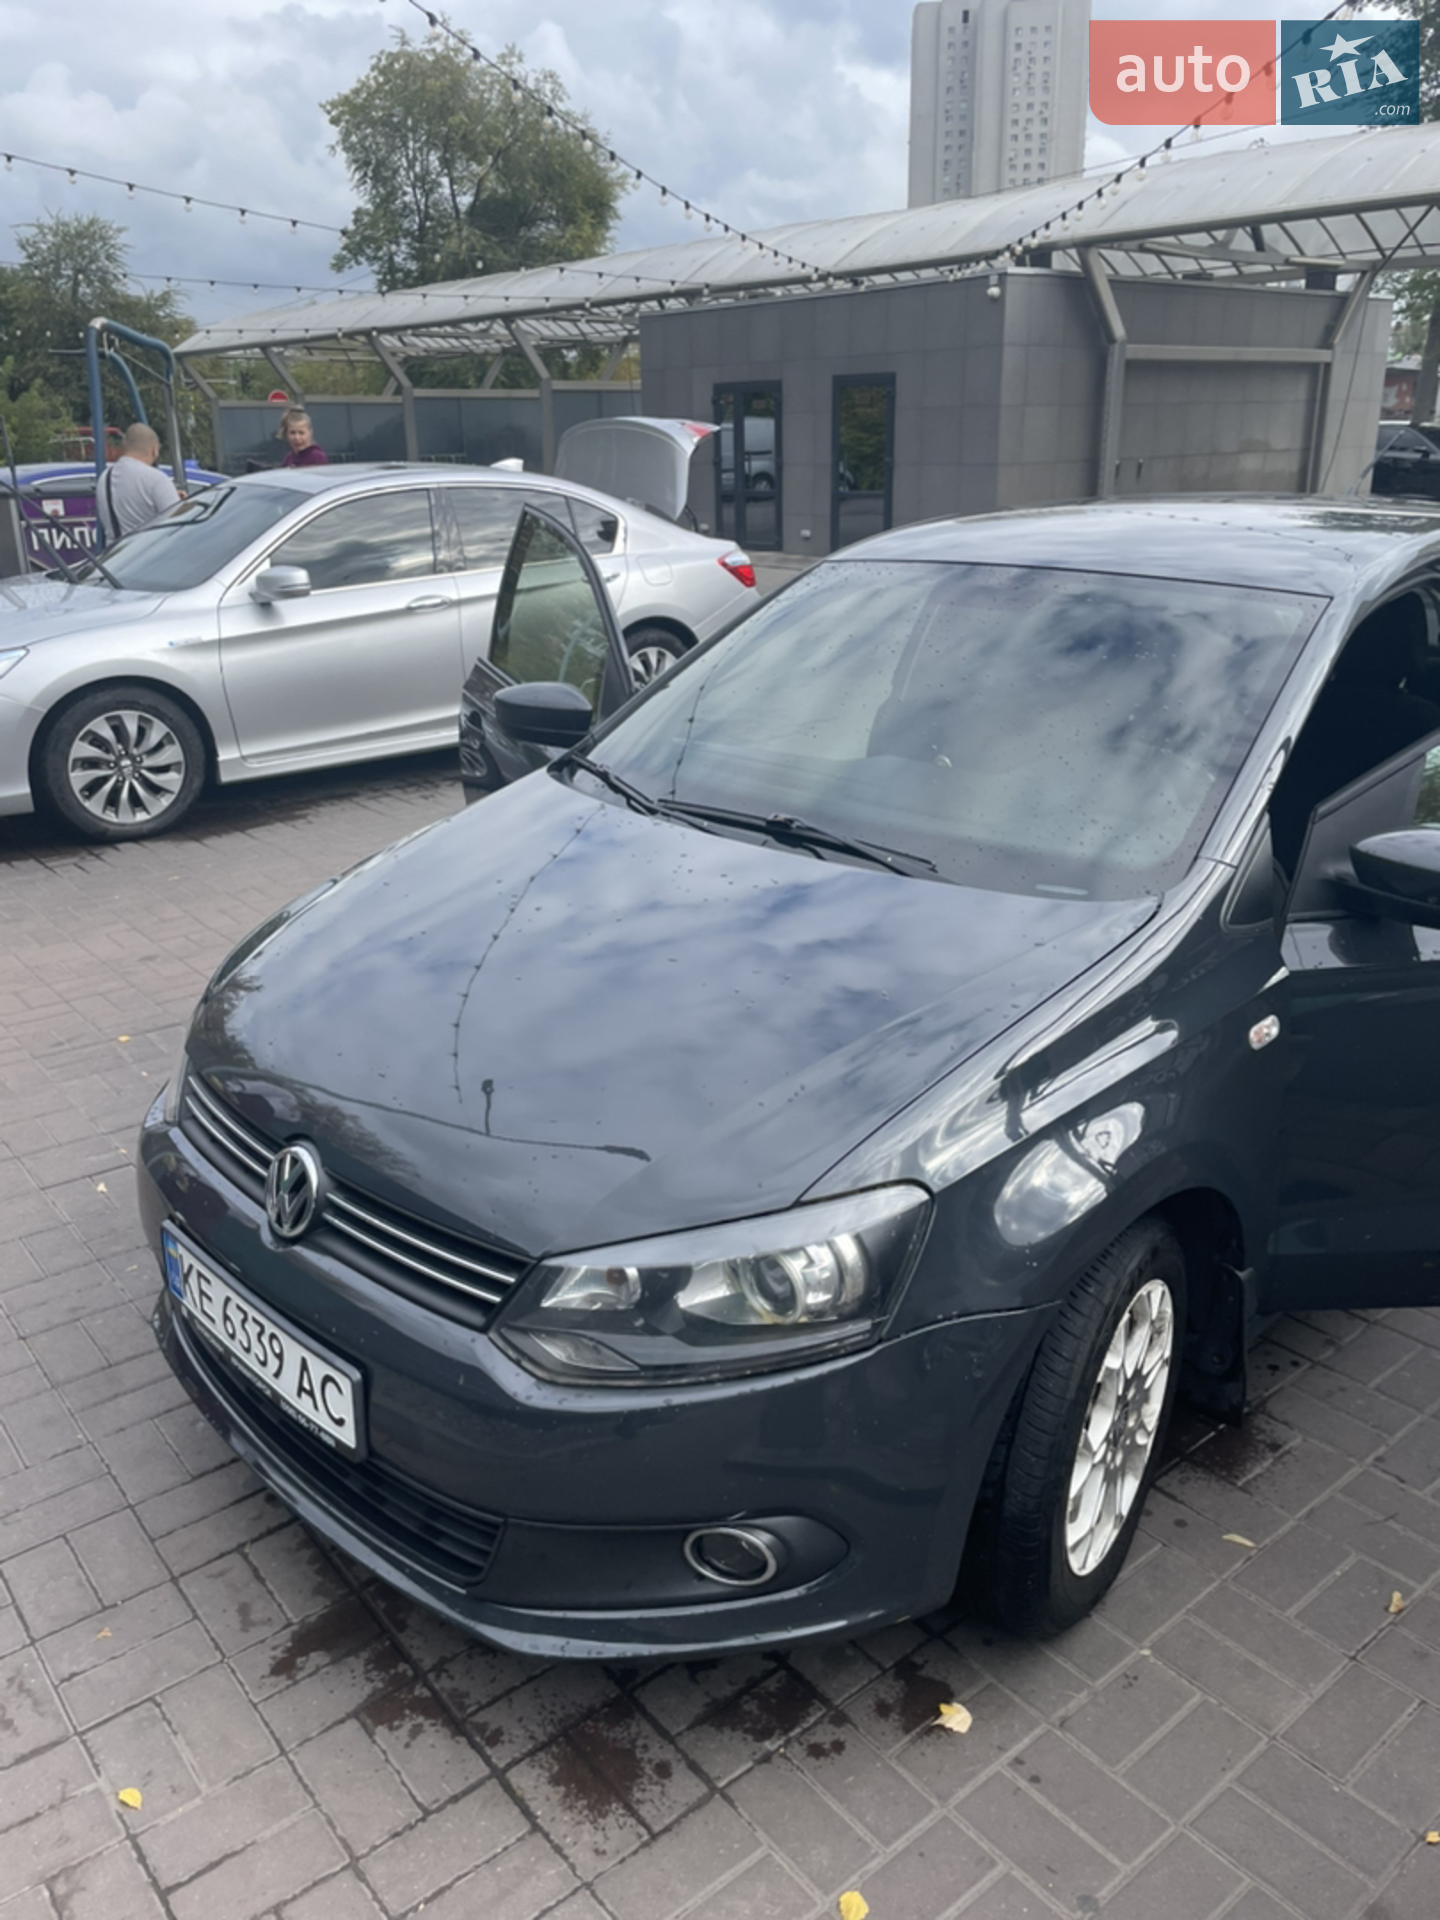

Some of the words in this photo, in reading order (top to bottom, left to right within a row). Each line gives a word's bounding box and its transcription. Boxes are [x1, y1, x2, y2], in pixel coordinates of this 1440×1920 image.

[178, 1252, 217, 1326] KE
[222, 1295, 286, 1380] 6339
[296, 1355, 347, 1428] AC
